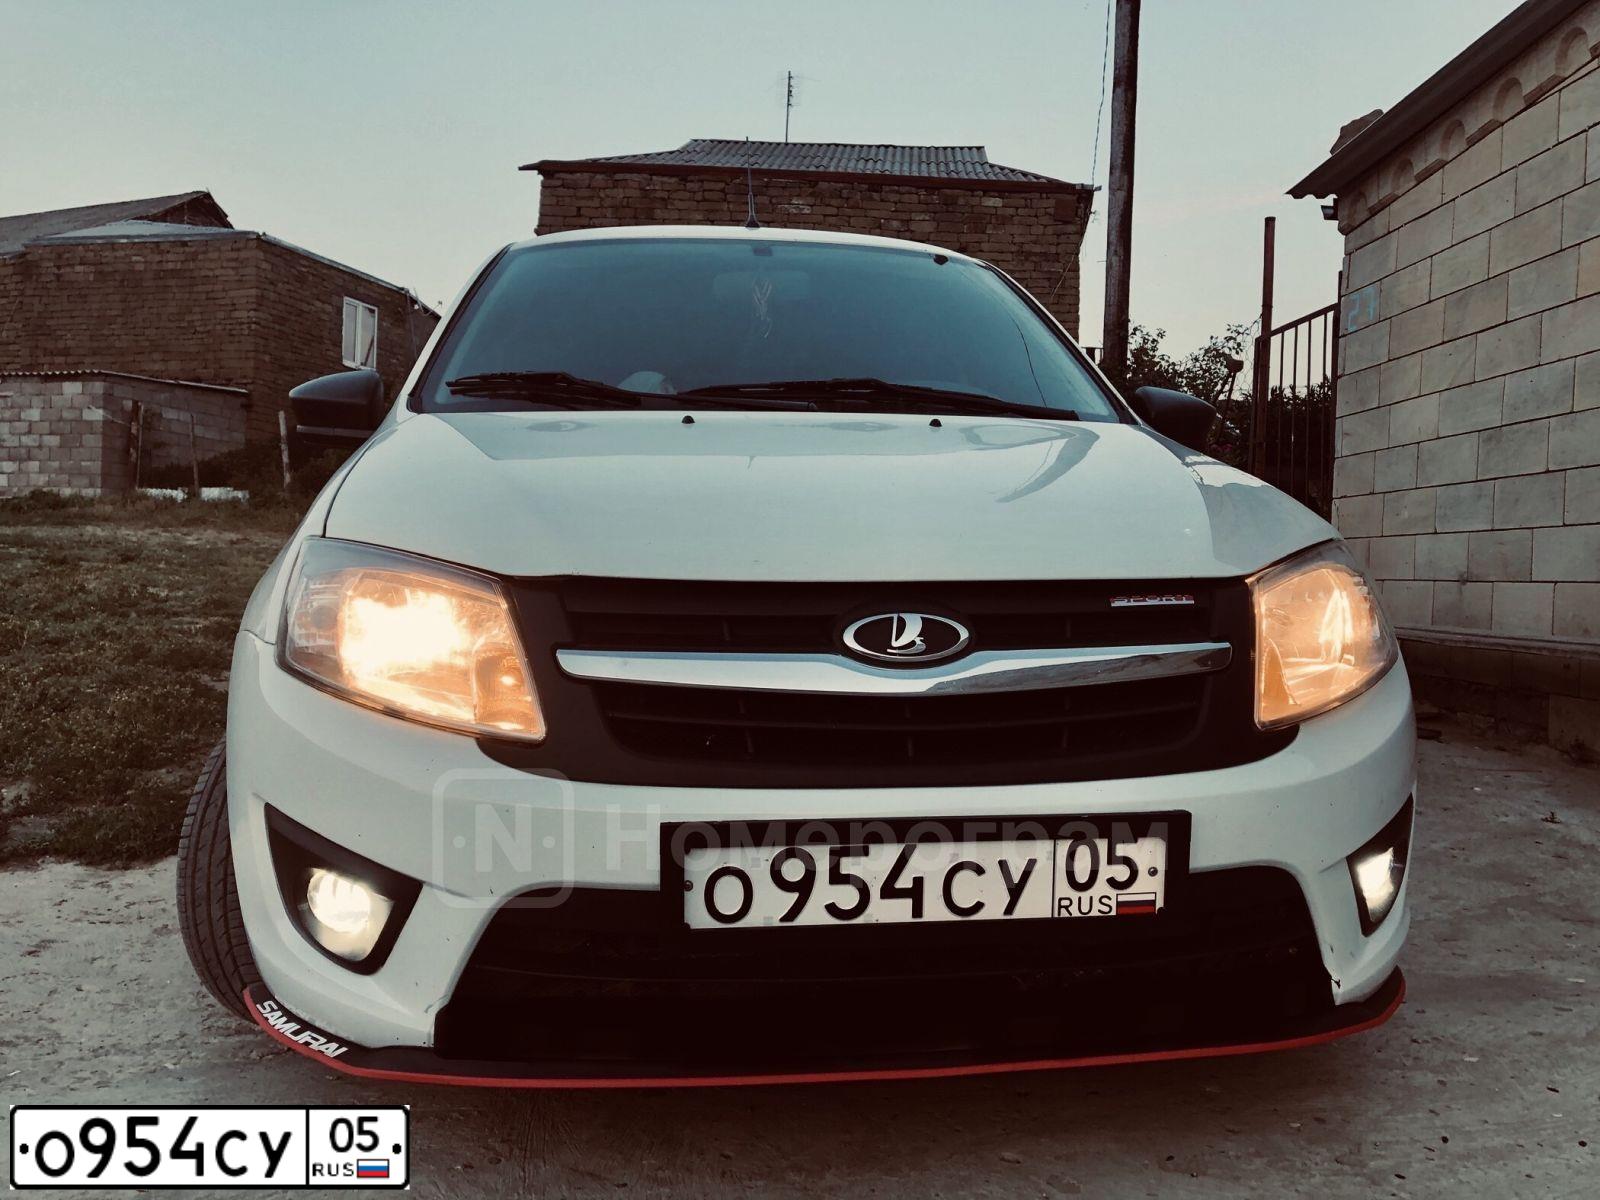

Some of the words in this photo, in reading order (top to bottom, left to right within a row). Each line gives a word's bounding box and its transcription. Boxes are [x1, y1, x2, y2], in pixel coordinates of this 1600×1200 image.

[1064, 838, 1140, 892] 05
[1057, 894, 1113, 917] RUS
[255, 1000, 349, 1058] SAMURAI
